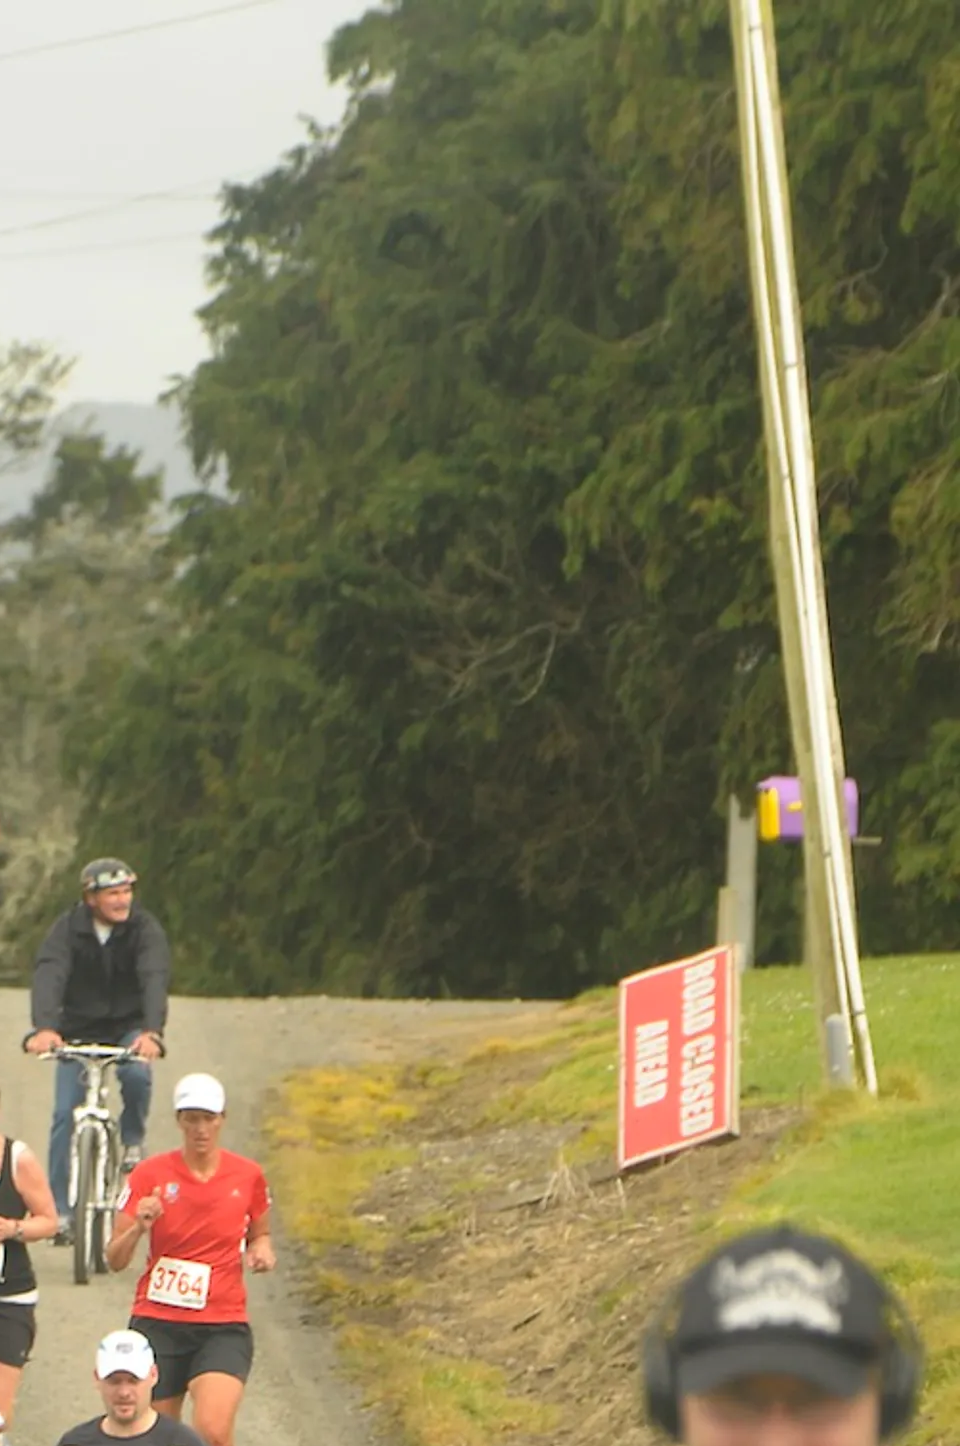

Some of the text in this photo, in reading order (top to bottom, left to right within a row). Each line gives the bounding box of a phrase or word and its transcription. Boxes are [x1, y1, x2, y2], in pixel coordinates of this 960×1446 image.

[634, 1020, 669, 1108] AHEAD
[680, 959, 716, 1137] ROAD CLOSED
[153, 1266, 204, 1297] 3764
